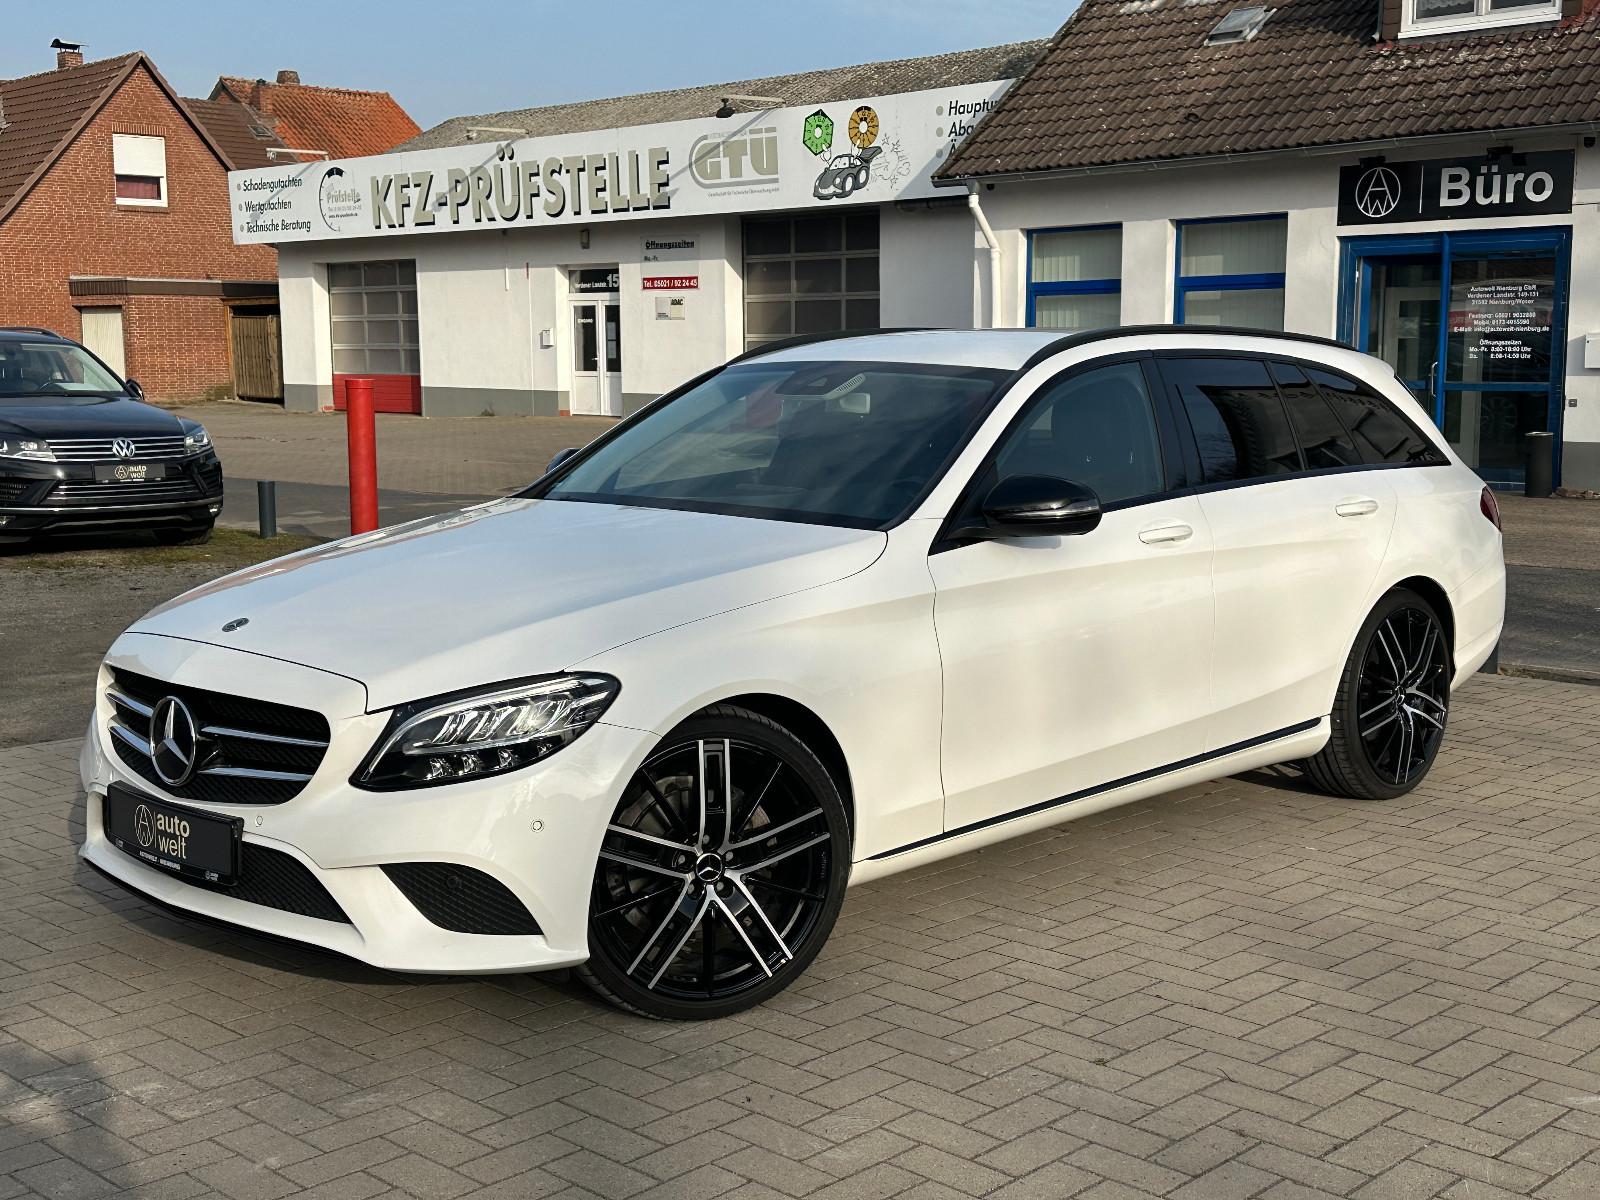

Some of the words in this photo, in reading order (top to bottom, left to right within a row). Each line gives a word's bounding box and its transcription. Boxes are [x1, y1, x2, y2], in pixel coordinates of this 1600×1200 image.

[948, 98, 999, 118] Hauptu
[693, 126, 779, 181] GTÜ
[243, 174, 303, 192] Schadengutachten
[370, 142, 671, 230] KFZ-PRÜFSTELLE
[1439, 164, 1554, 208] Büro
[244, 196, 292, 215] Wertgutachten
[246, 218, 279, 233] Technische
[281, 219, 311, 233] Beratung
[157, 813, 190, 838] auto
[158, 835, 187, 859] welt
